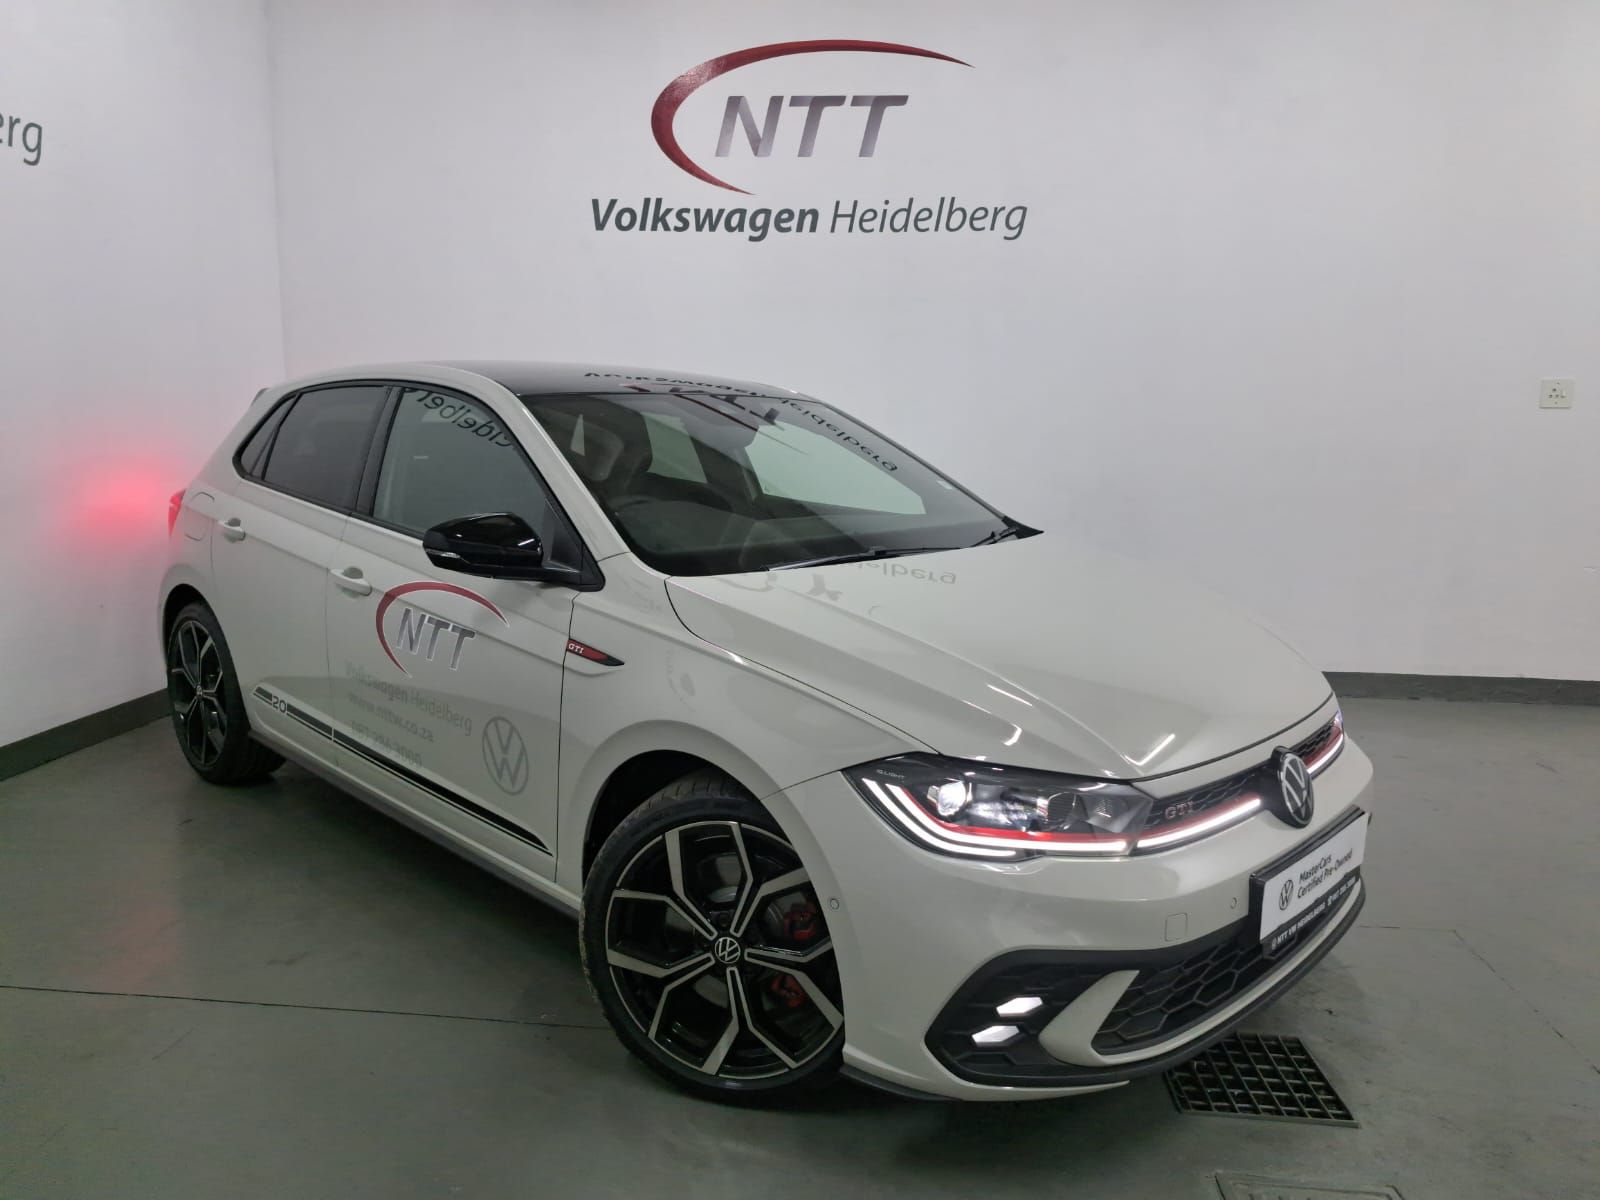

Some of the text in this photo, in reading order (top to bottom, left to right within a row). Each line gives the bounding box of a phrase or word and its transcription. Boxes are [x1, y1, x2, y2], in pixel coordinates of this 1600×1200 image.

[714, 95, 909, 157] NTT
[591, 197, 1028, 242] Volkswagen Heidelberg
[396, 607, 475, 670] NTT
[568, 643, 585, 654] GTI
[271, 695, 287, 713] 20
